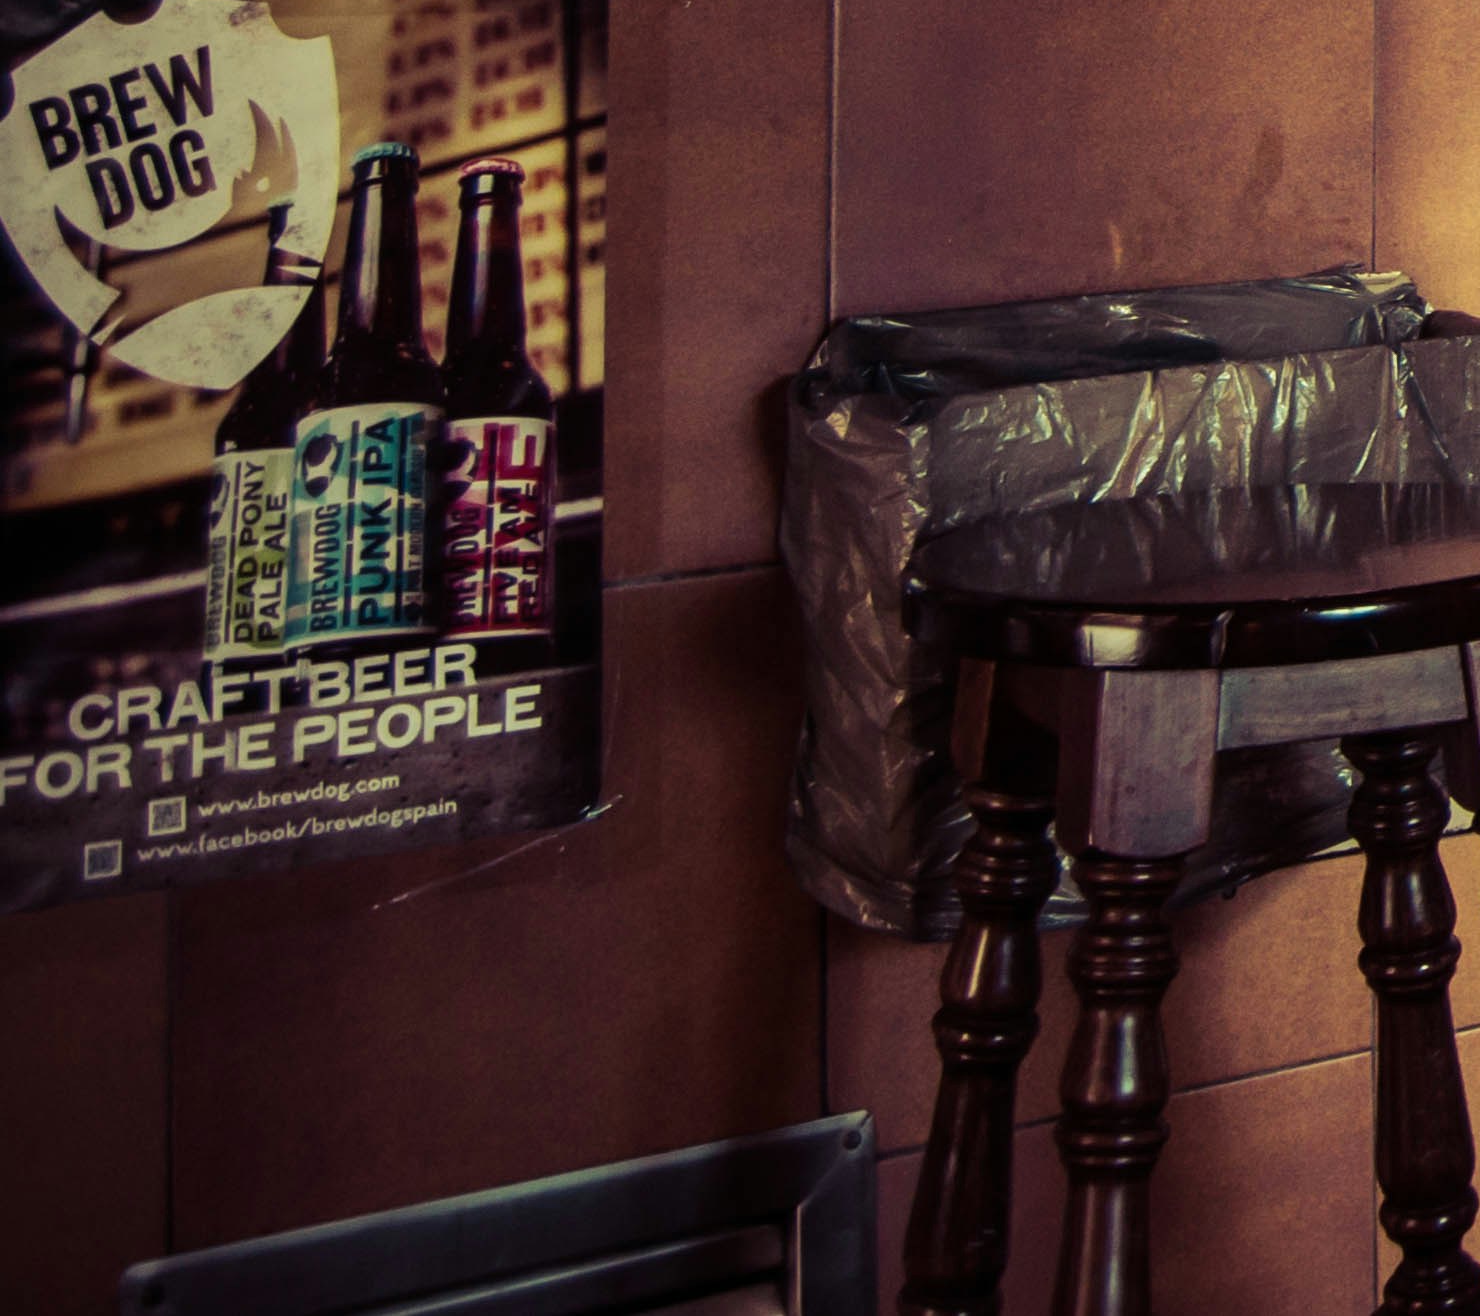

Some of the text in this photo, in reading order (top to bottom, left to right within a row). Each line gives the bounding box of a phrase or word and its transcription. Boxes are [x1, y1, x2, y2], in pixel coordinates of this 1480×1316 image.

[29, 45, 214, 171] BREW
[85, 129, 217, 230] DOG
[233, 461, 265, 644] DEAD PONY
[257, 491, 288, 643] PALE ALE
[310, 502, 342, 634] BREWDOG
[357, 416, 396, 627] PUNK IPA
[0, 684, 544, 807] FOR THE PEOPLE
[69, 643, 478, 741] CRAFT BEER
[136, 796, 458, 862] www.facebook/brewdogspain
[198, 772, 400, 819] www.brewdog.com
